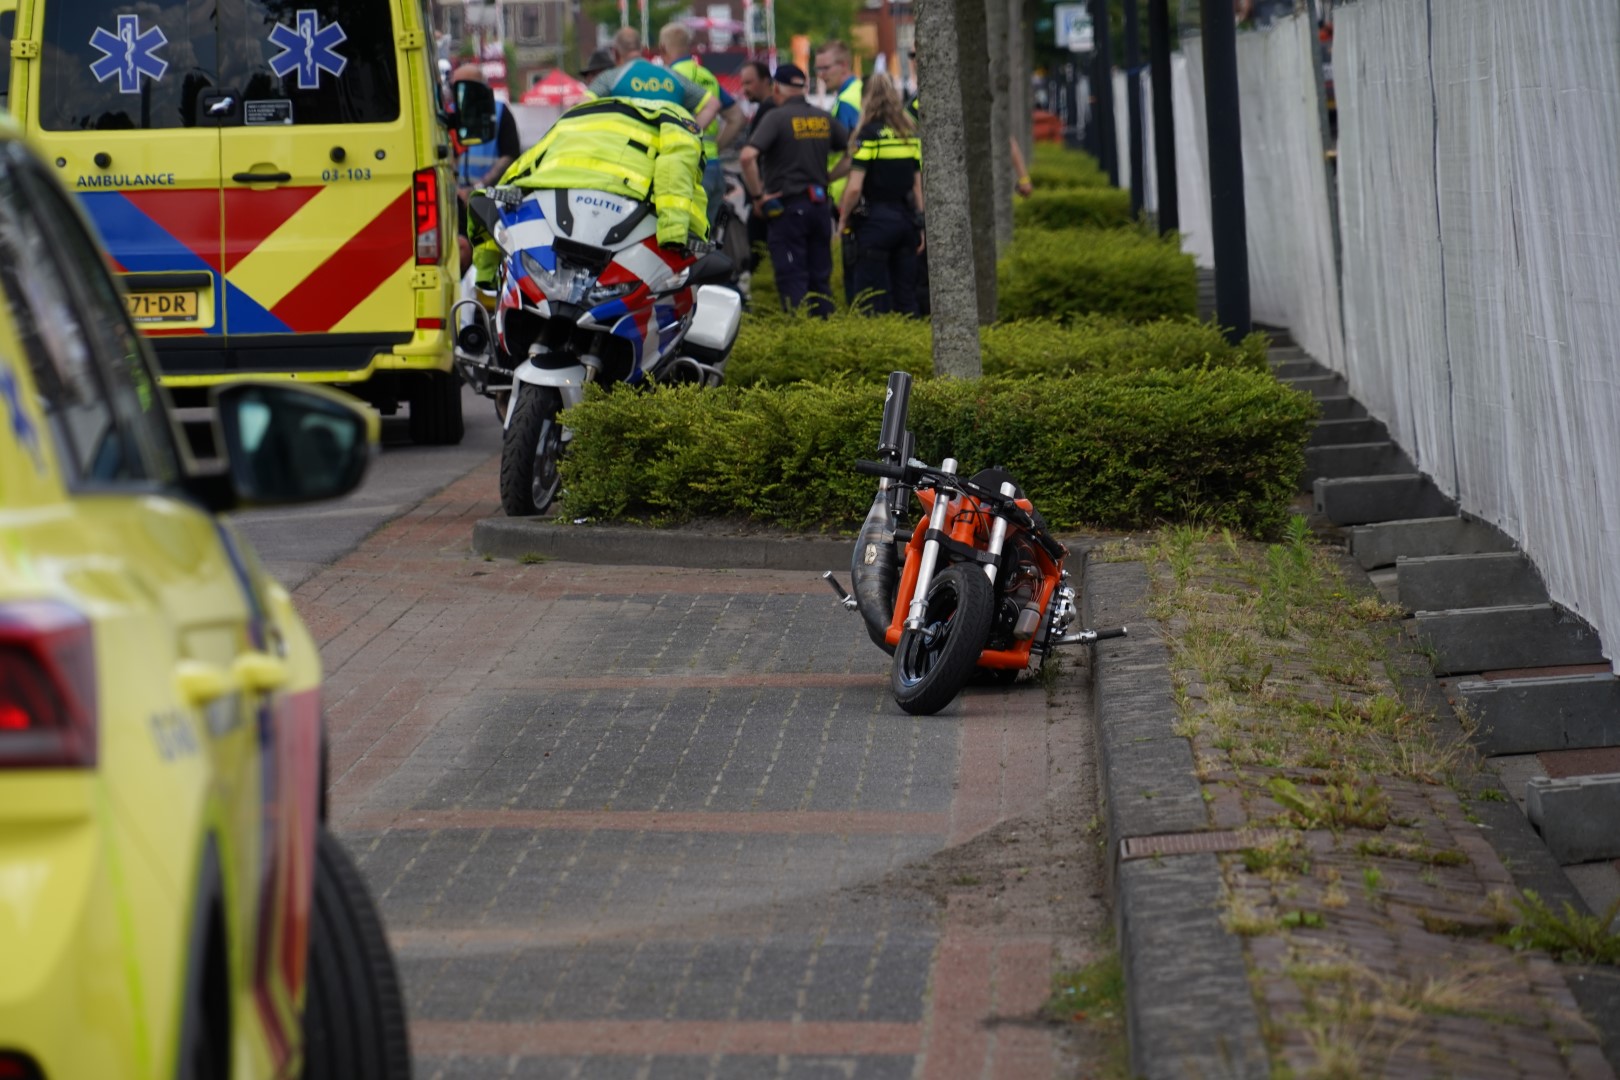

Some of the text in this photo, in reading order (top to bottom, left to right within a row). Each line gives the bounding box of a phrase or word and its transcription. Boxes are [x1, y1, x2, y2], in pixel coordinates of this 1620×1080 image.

[77, 173, 175, 187] AMBULANCE
[322, 168, 371, 181] 03-103
[575, 195, 623, 214] POLITIE
